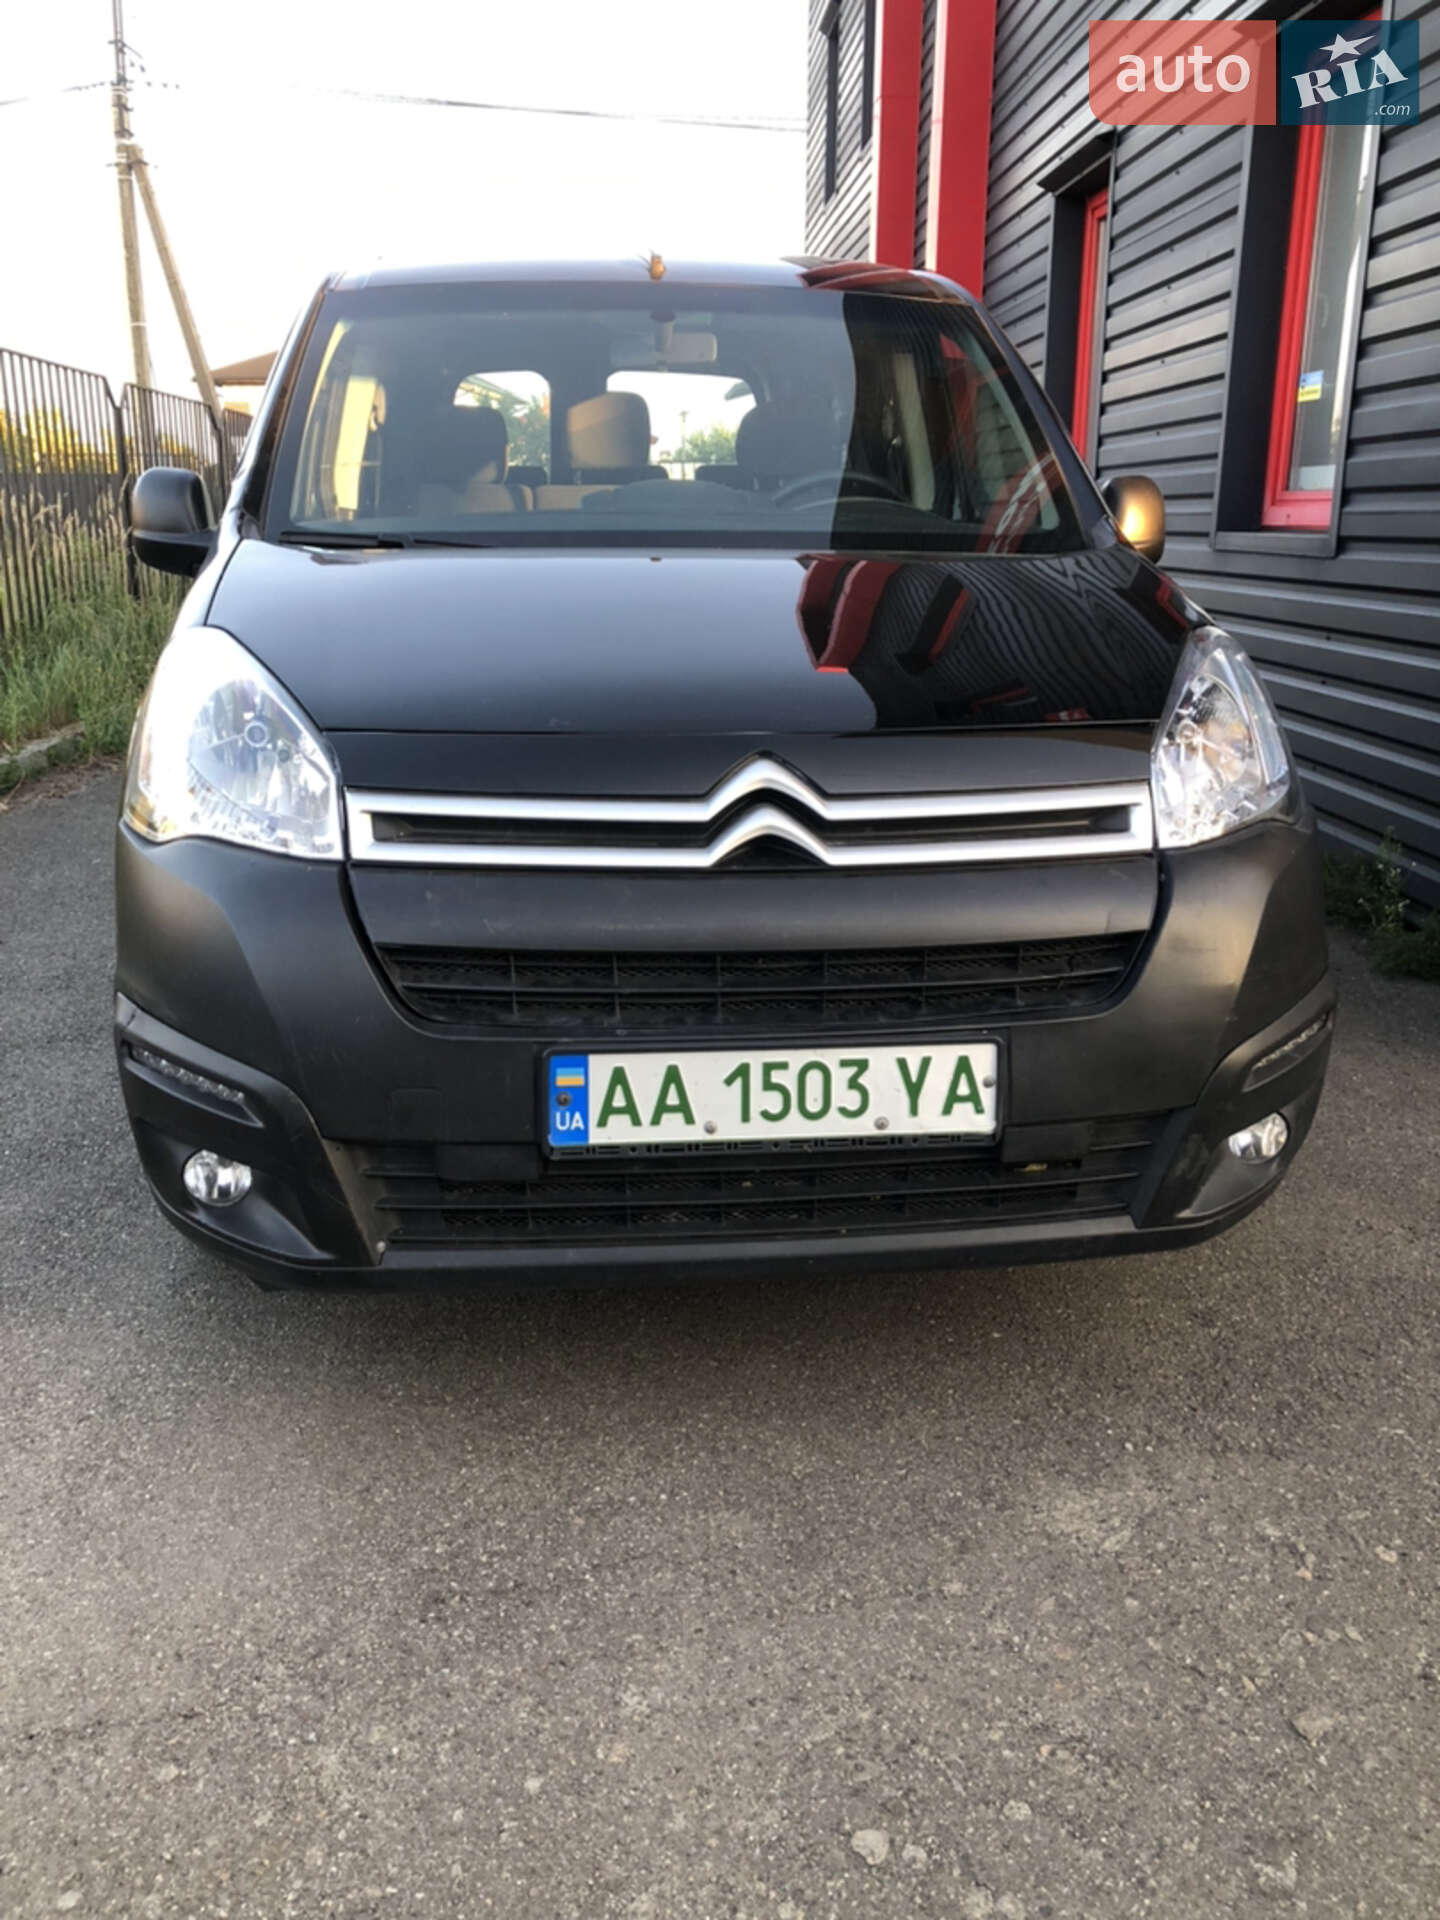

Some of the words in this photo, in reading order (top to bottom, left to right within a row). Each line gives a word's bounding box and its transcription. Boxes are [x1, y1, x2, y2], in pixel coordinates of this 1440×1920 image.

[596, 1064, 696, 1128] AA
[723, 1059, 870, 1123] 1503
[895, 1055, 985, 1117] YA
[555, 1111, 585, 1131] UA
